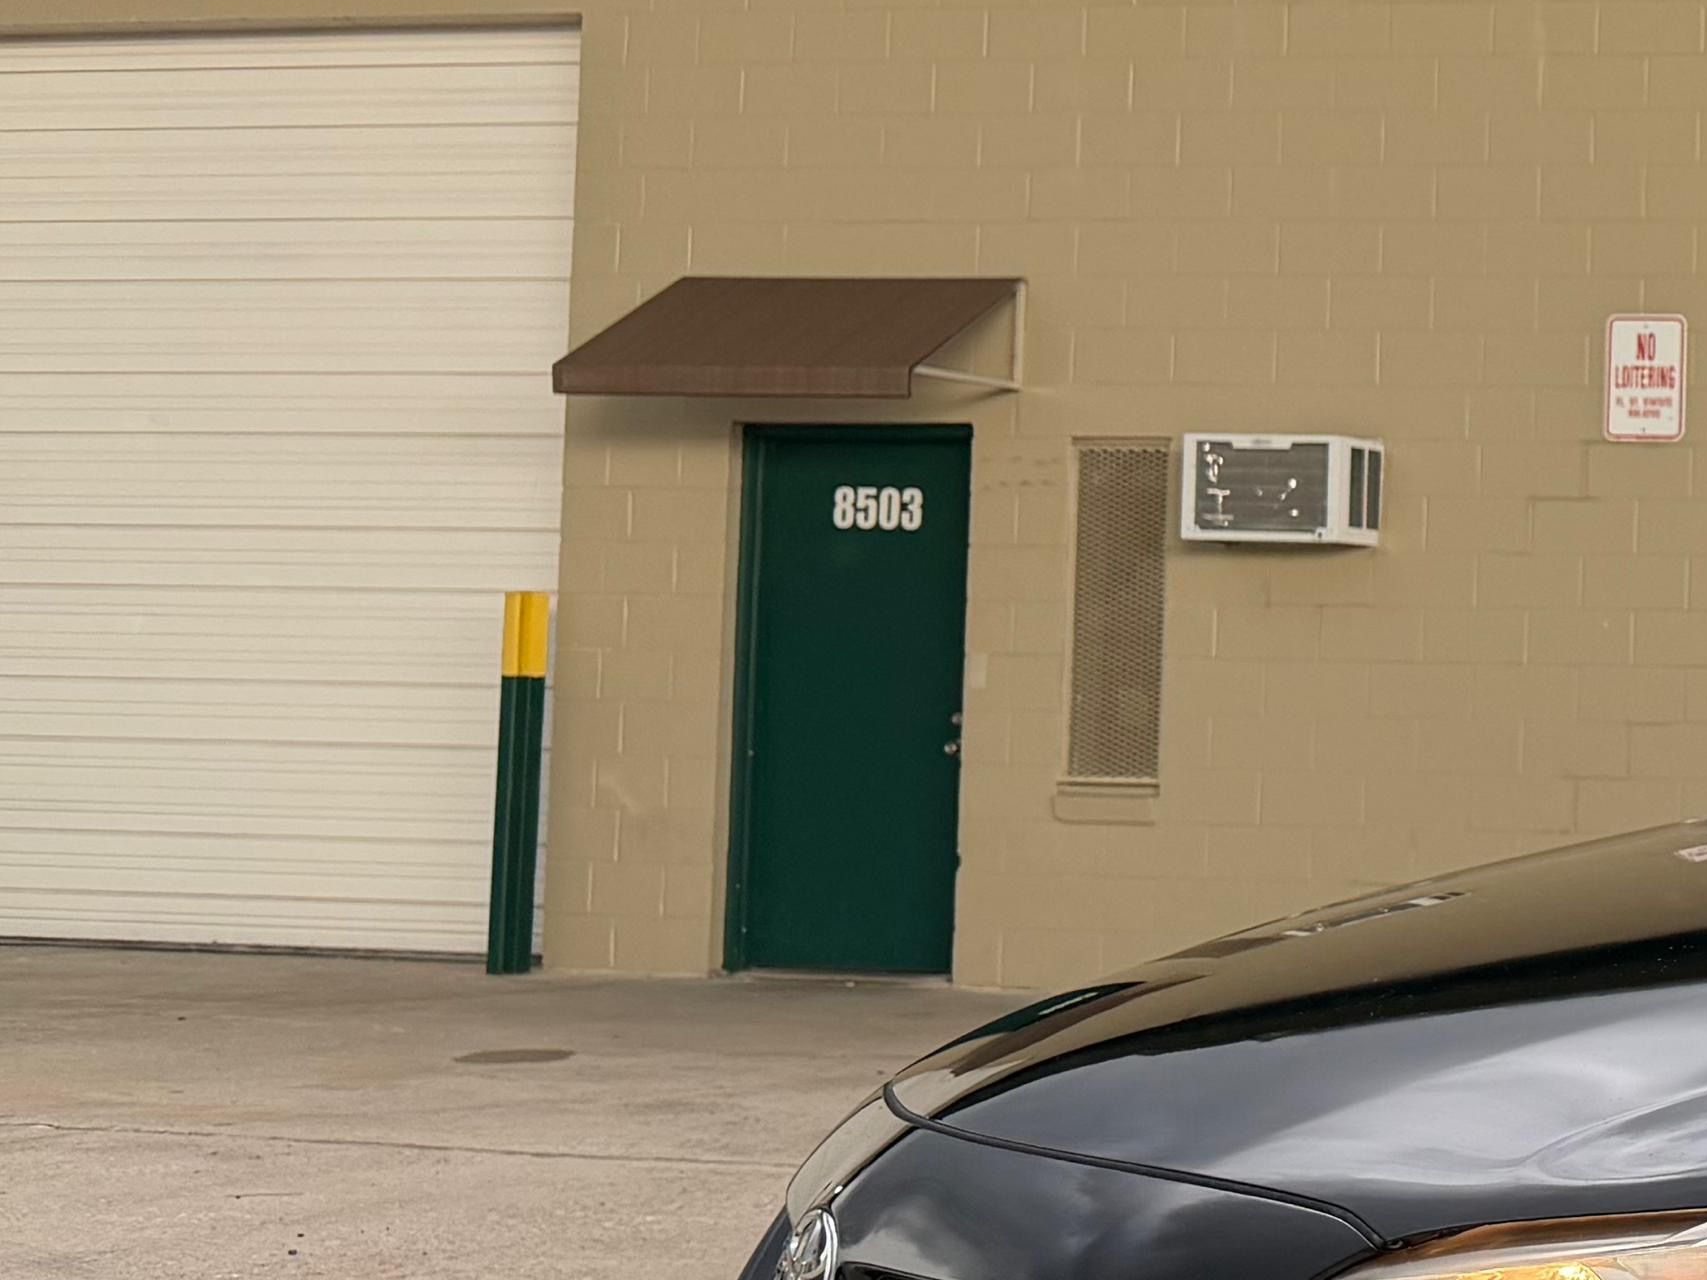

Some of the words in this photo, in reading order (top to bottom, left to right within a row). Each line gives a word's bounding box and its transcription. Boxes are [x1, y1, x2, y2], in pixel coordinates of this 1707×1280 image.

[1636, 333, 1656, 361] NO
[1615, 365, 1676, 389] LOITERING
[833, 485, 924, 531] 8503
